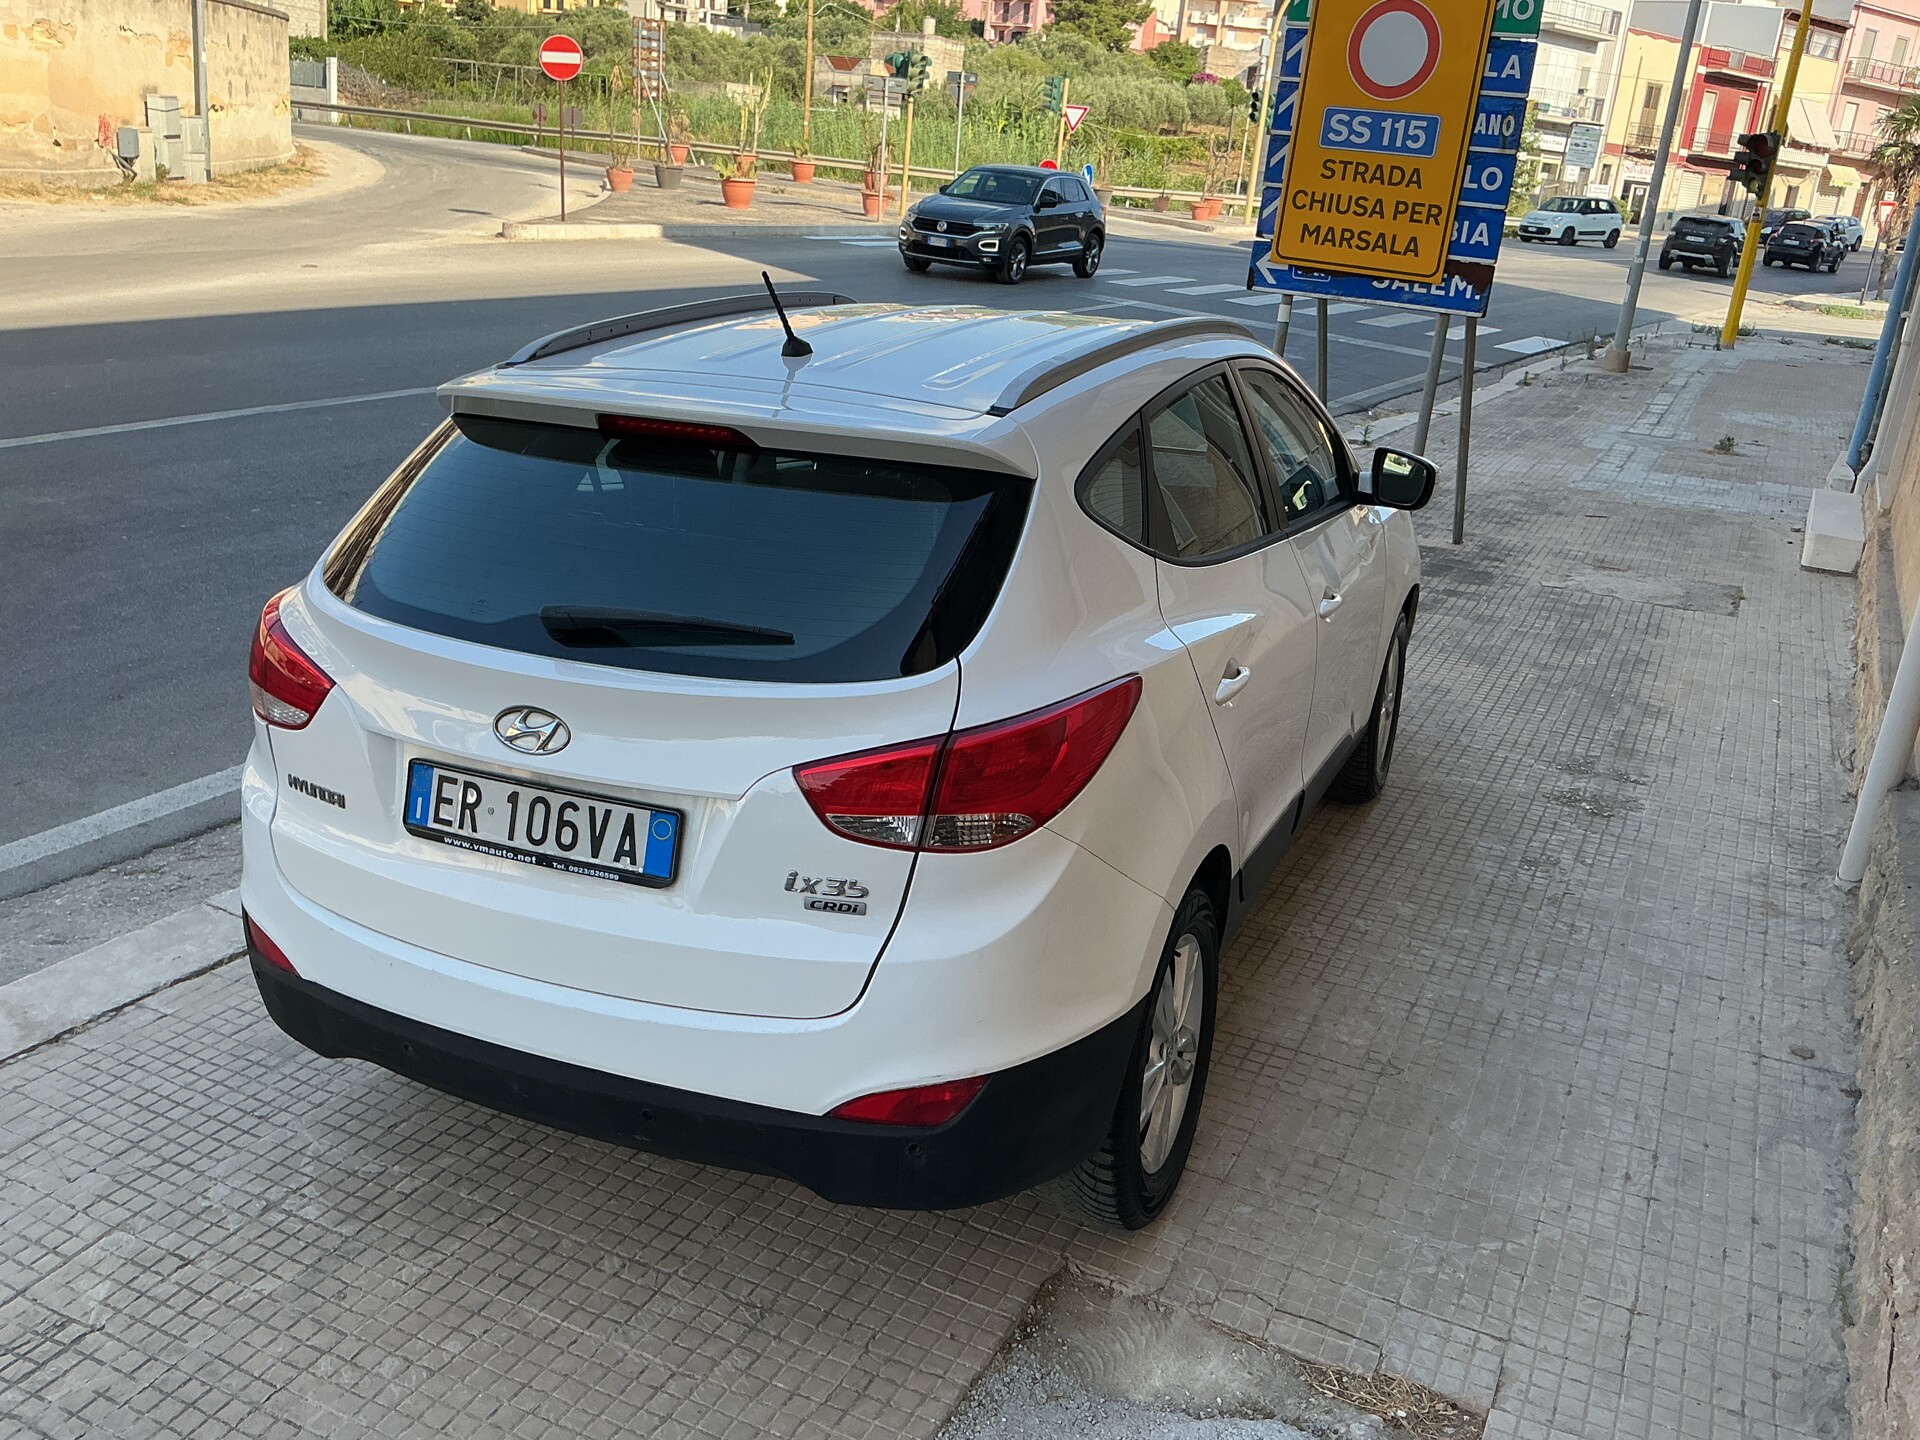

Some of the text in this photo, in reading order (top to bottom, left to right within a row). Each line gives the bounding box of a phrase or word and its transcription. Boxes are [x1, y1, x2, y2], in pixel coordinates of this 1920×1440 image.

[1327, 113, 1427, 149] SS 115
[1320, 158, 1422, 190] STRADA
[1292, 189, 1443, 226] CHIUSA PER
[1300, 223, 1420, 258] MARSALA
[433, 774, 638, 866] ER 106VA
[443, 836, 537, 865] www.vmauto.net
[552, 861, 566, 870] Tel.
[568, 865, 620, 881] 0923/526599
[810, 900, 859, 913] CRDi
